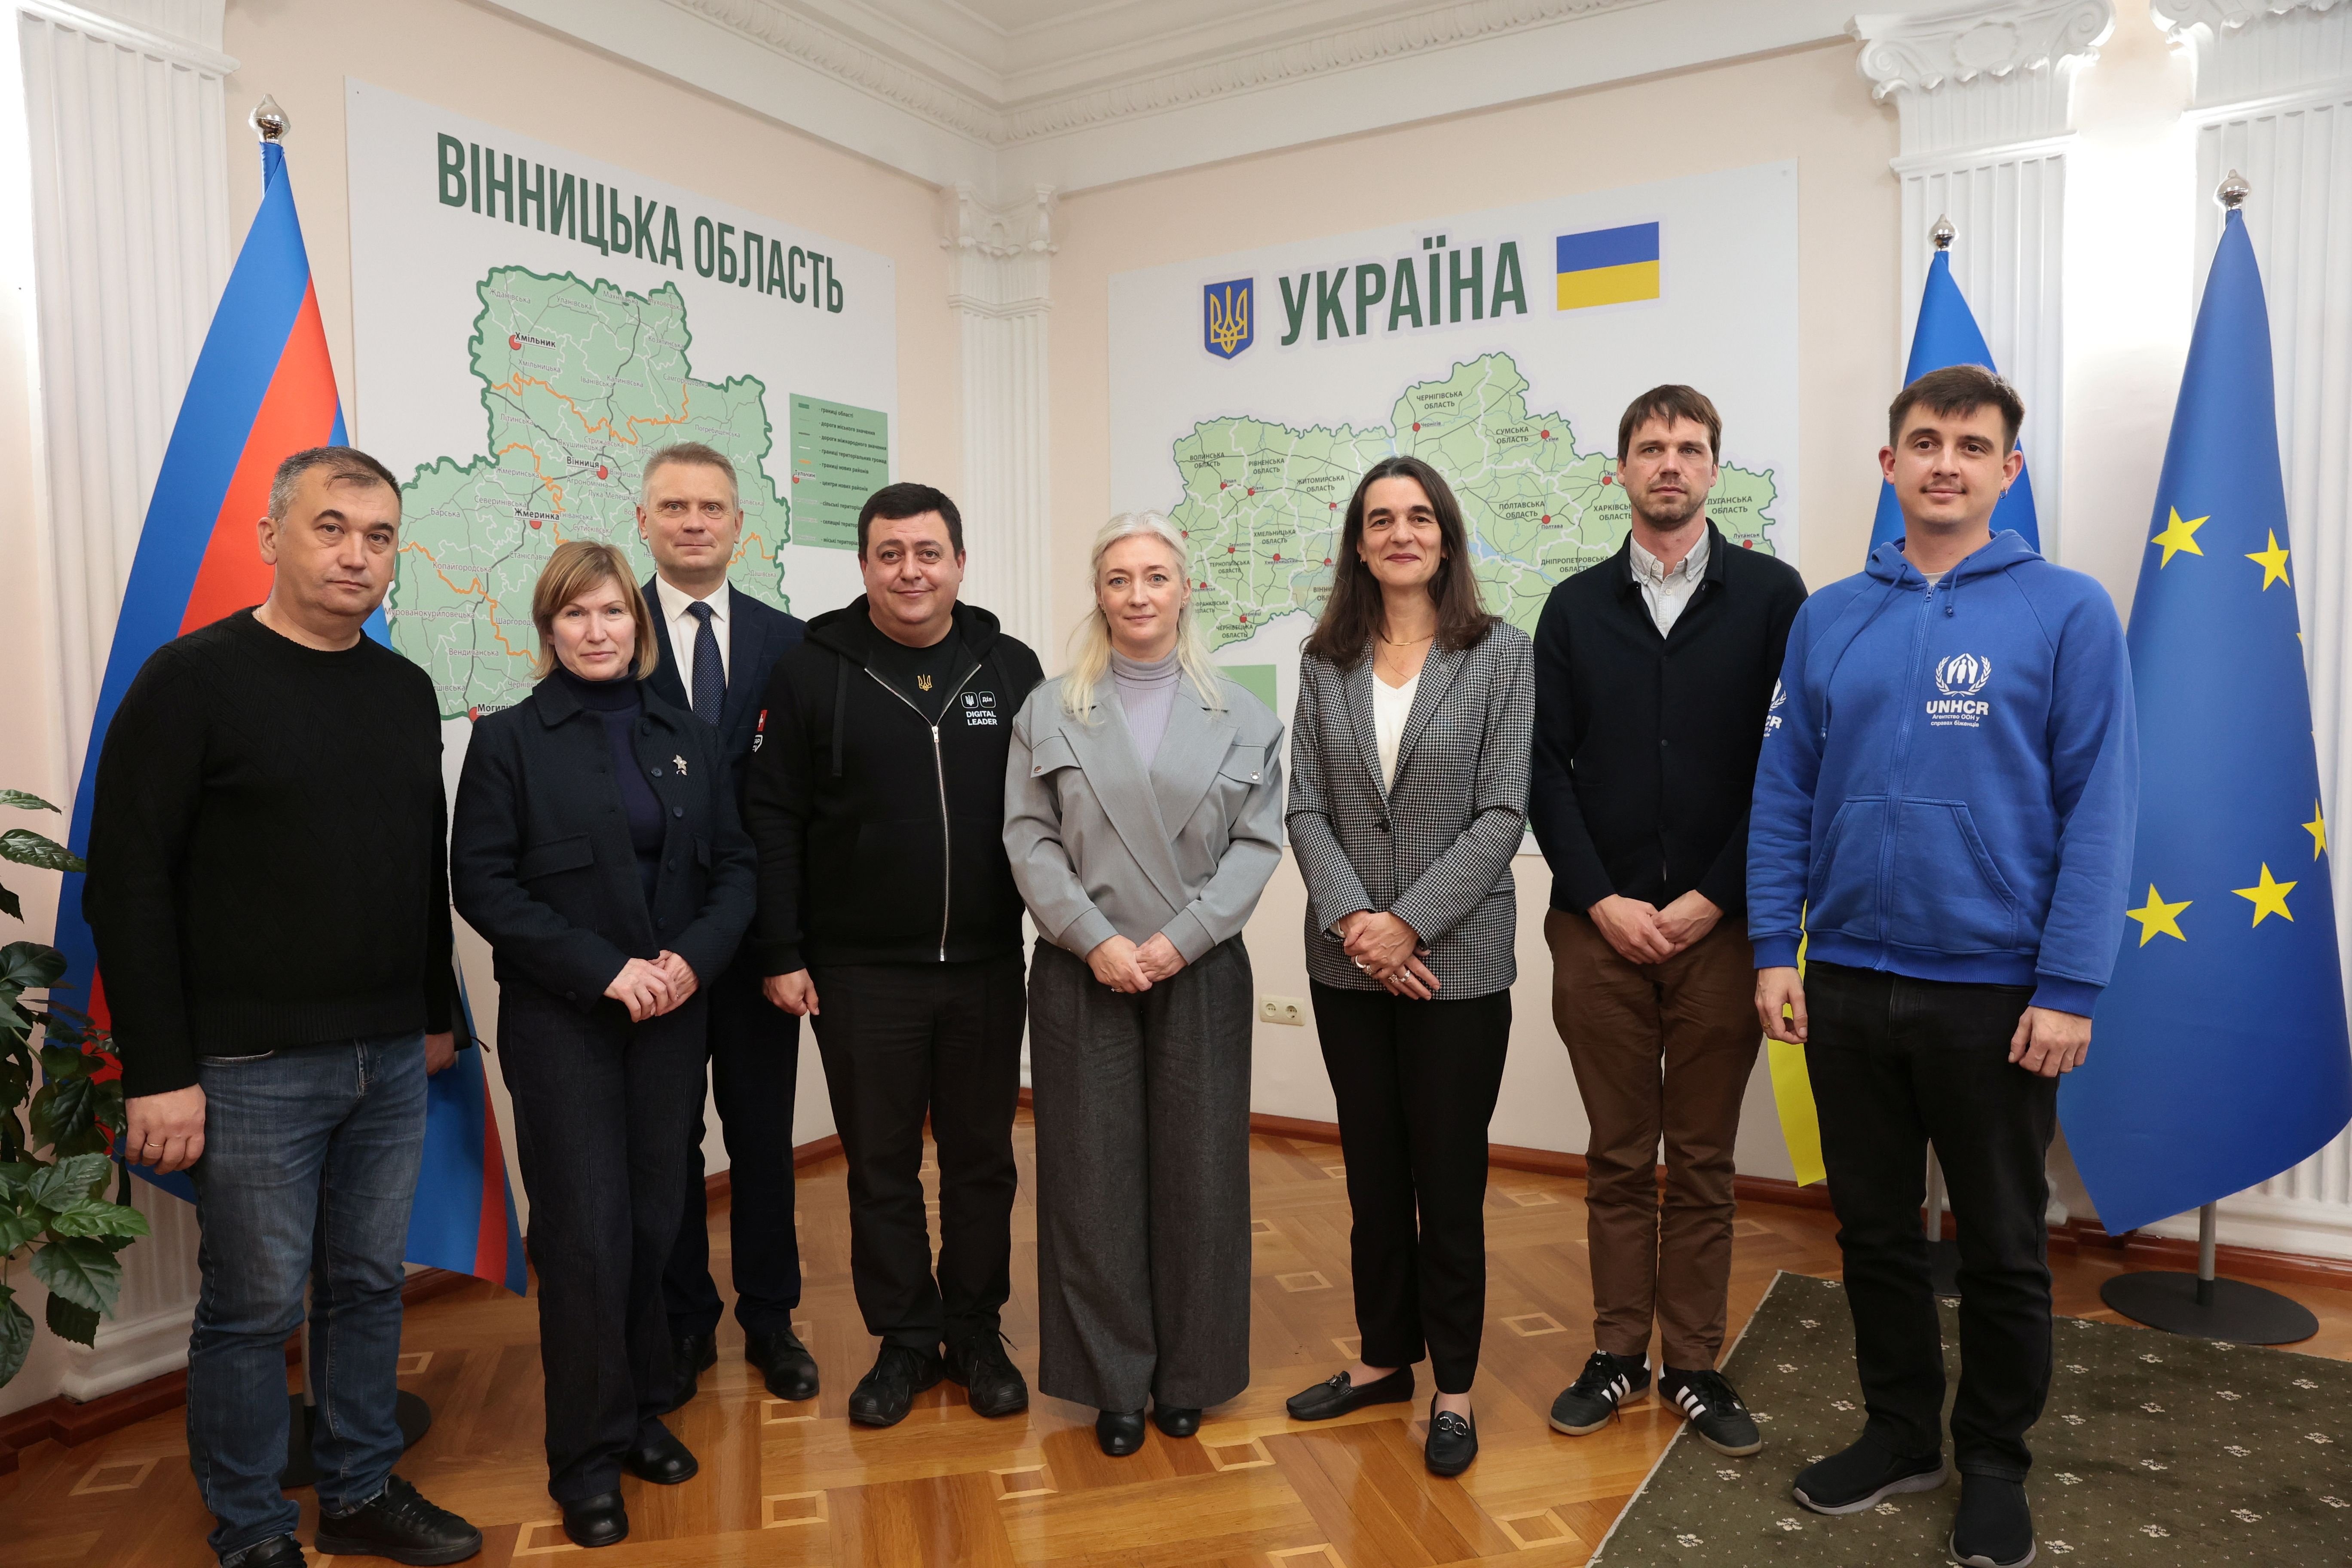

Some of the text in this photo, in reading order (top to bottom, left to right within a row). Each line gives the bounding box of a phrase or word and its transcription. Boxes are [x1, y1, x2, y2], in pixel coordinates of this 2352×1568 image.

[437, 132, 843, 313] ВІННИЦЬКА ОБЛАСТЬ
[490, 288, 531, 304] Жданівська
[1278, 235, 1528, 346] УКРАЇНА
[557, 295, 592, 310] Уланівська
[515, 332, 556, 348] Хмільник
[648, 336, 684, 349] Козятинська
[518, 358, 561, 373] Хмільницька
[581, 376, 614, 388] Іванівська
[607, 375, 643, 387] Калинівська
[1417, 391, 1463, 401] ЧЕРНІГІВСЬКА
[1424, 401, 1455, 410] ОБЛАСТЬ
[500, 413, 534, 425] Літинська
[695, 424, 740, 438] Погребищенська
[1496, 426, 1529, 435] СУМСЬКА
[558, 438, 602, 451] Якушинецька
[584, 436, 624, 448] Стрижавська
[1190, 452, 1225, 460] ВОЛИНСЬКА
[567, 456, 599, 468] Вінниця
[1248, 458, 1285, 467] РІВНЕНСЬКА
[496, 467, 539, 478] Жмеринська
[795, 470, 815, 478] Тульчин
[567, 477, 608, 488] Агрономічна
[1297, 475, 1344, 484] ЖИТОМИРСЬКА
[474, 496, 527, 508] Северинівська
[1499, 501, 1545, 510] ПОЛТАВСЬКА
[1707, 496, 1752, 505] ЛУГАНСЬКА
[431, 508, 460, 518] Барська
[514, 508, 559, 520] Жмеринка
[1712, 506, 1748, 514] ОБЛАСТЬ
[509, 551, 551, 560] Станіславчи
[1541, 556, 1608, 566] ДНІПРОПЕТРОВСЬКА
[433, 562, 492, 573] Копайгородська
[449, 648, 499, 656] Вендичанська
[1926, 700, 1989, 715] UNHCR
